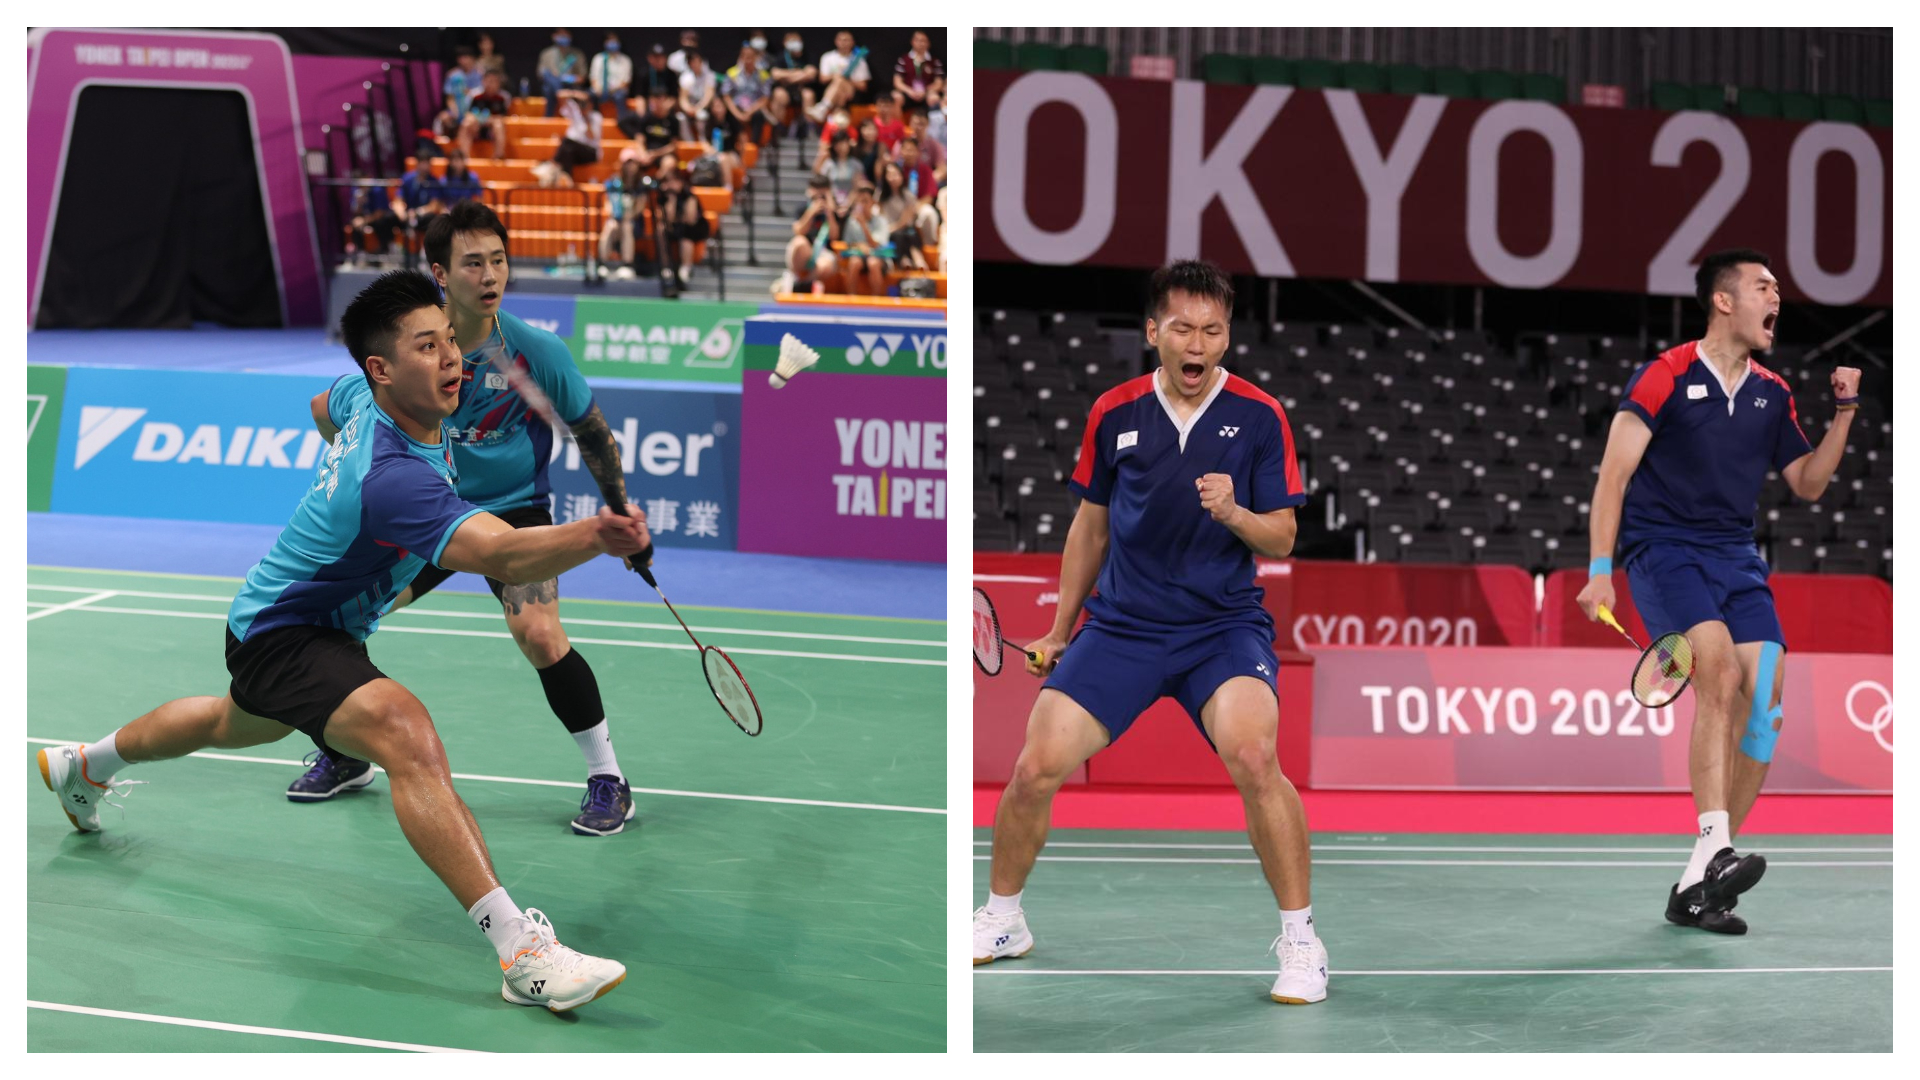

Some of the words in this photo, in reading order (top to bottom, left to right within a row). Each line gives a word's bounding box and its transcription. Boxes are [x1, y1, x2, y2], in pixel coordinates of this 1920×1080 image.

[992, 70, 1584, 289] OKYO
[1646, 109, 1885, 306] 20
[132, 421, 332, 469] DAIKI
[834, 418, 947, 470] YONE
[832, 469, 946, 519] TAIPEI
[1376, 615, 1478, 647] 2020
[1361, 686, 1538, 735] TOKYO
[1549, 688, 1676, 737] 2020
